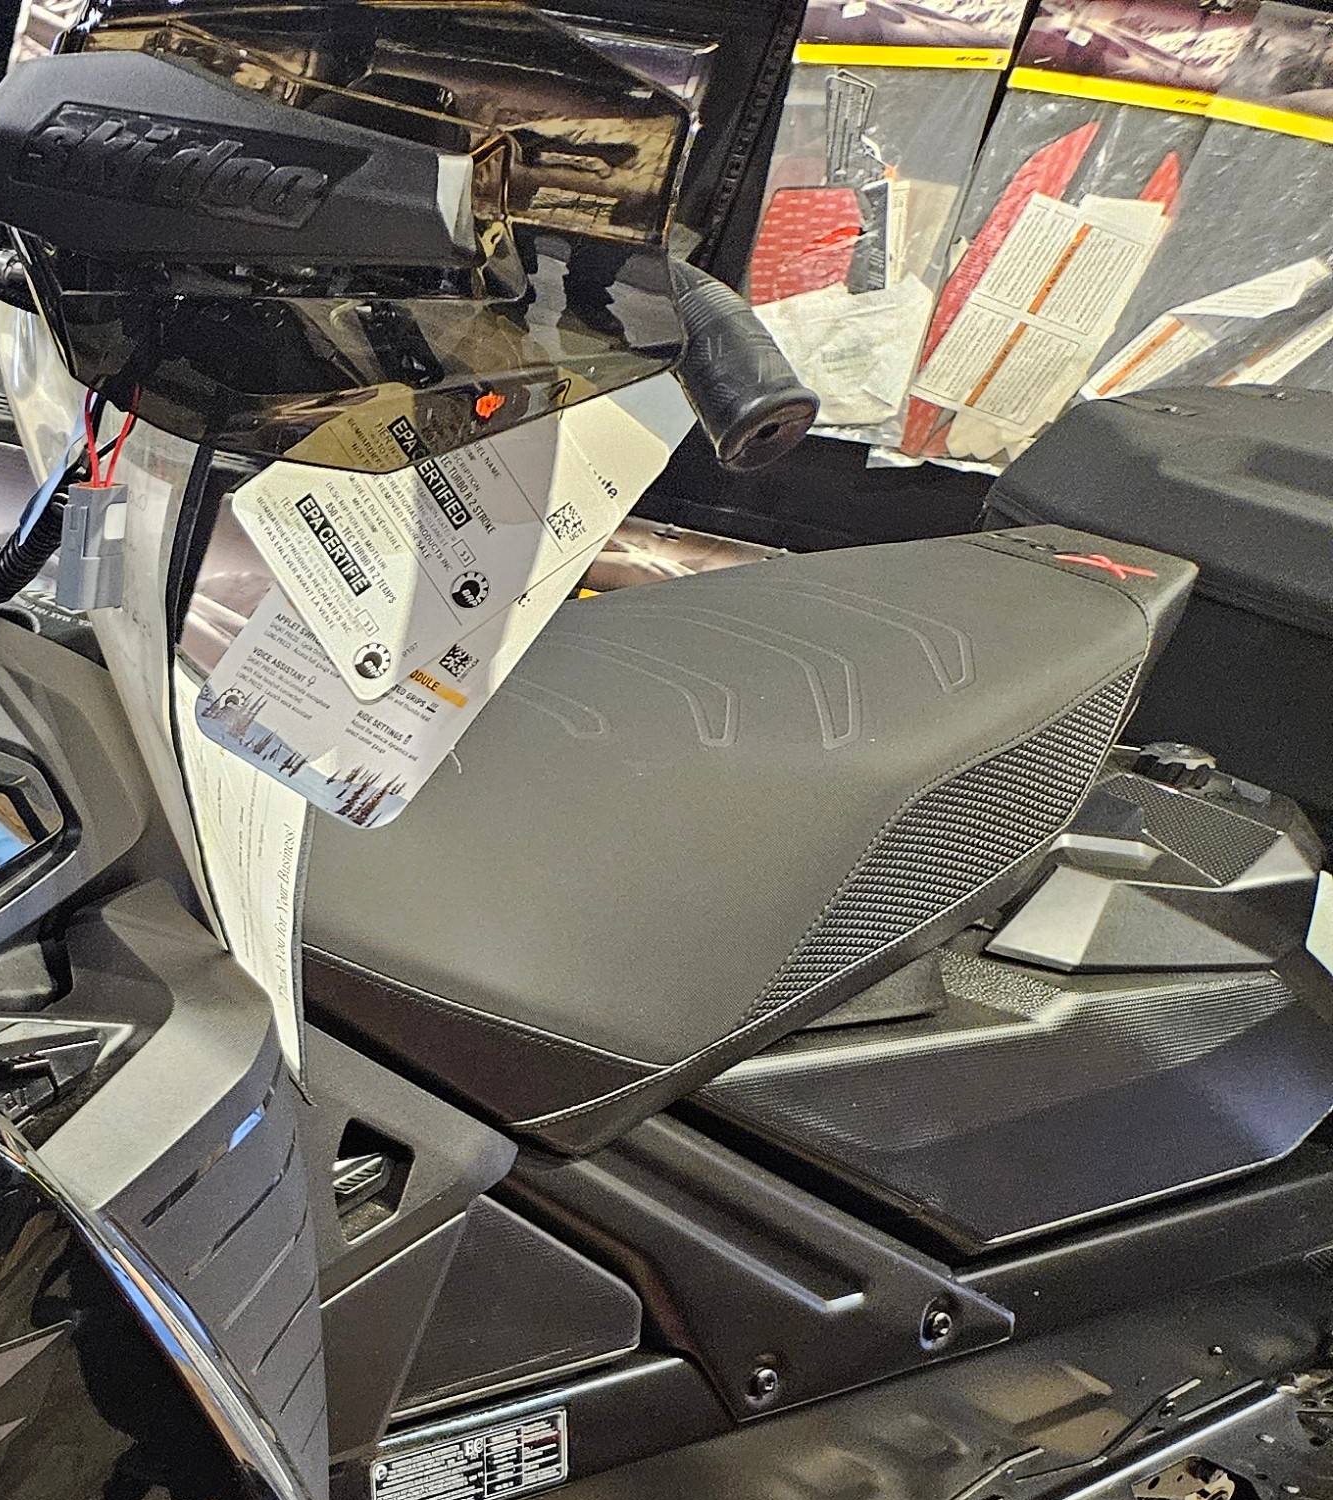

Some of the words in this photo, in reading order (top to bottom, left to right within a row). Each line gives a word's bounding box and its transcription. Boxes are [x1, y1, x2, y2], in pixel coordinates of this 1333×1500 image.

[28, 118, 329, 216] ski-doo
[391, 418, 421, 453] EPA
[409, 446, 469, 528] CERTIFIED
[447, 466, 469, 493] TURBO
[323, 500, 340, 517] 850
[324, 479, 361, 530] DESCRIPTION
[354, 527, 368, 542] DU
[367, 503, 379, 516] DU
[376, 481, 404, 519] REMOVED
[399, 516, 419, 541] PRIOR
[467, 498, 478, 507] 2
[472, 505, 496, 535] STROKE
[255, 494, 292, 544] BOMBARDIER
[286, 541, 316, 581] PRODUITS
[297, 496, 327, 532] EPA
[317, 523, 371, 594] CERTIFIÉ
[413, 518, 444, 560] PRODUCTS
[261, 522, 278, 541] PAS
[272, 538, 300, 575] ENLEVER
[294, 572, 314, 597] AVANT
[309, 595, 321, 608] LA
[350, 540, 372, 568] TURBO
[370, 571, 381, 581] 2
[374, 577, 397, 605] TEMPS
[263, 629, 277, 640] LONG
[274, 612, 301, 632] APPLET
[235, 670, 249, 682] LONG
[251, 645, 272, 662] VOICE
[270, 657, 307, 683] ASSISTANT
[405, 691, 426, 708] GRIPS
[356, 709, 373, 723] RIDE
[371, 718, 403, 741] SETTINGS
[364, 726, 373, 735] the
[276, 823, 297, 884] Business!
[277, 883, 291, 914] Your
[276, 914, 289, 937] for
[275, 937, 289, 962] You
